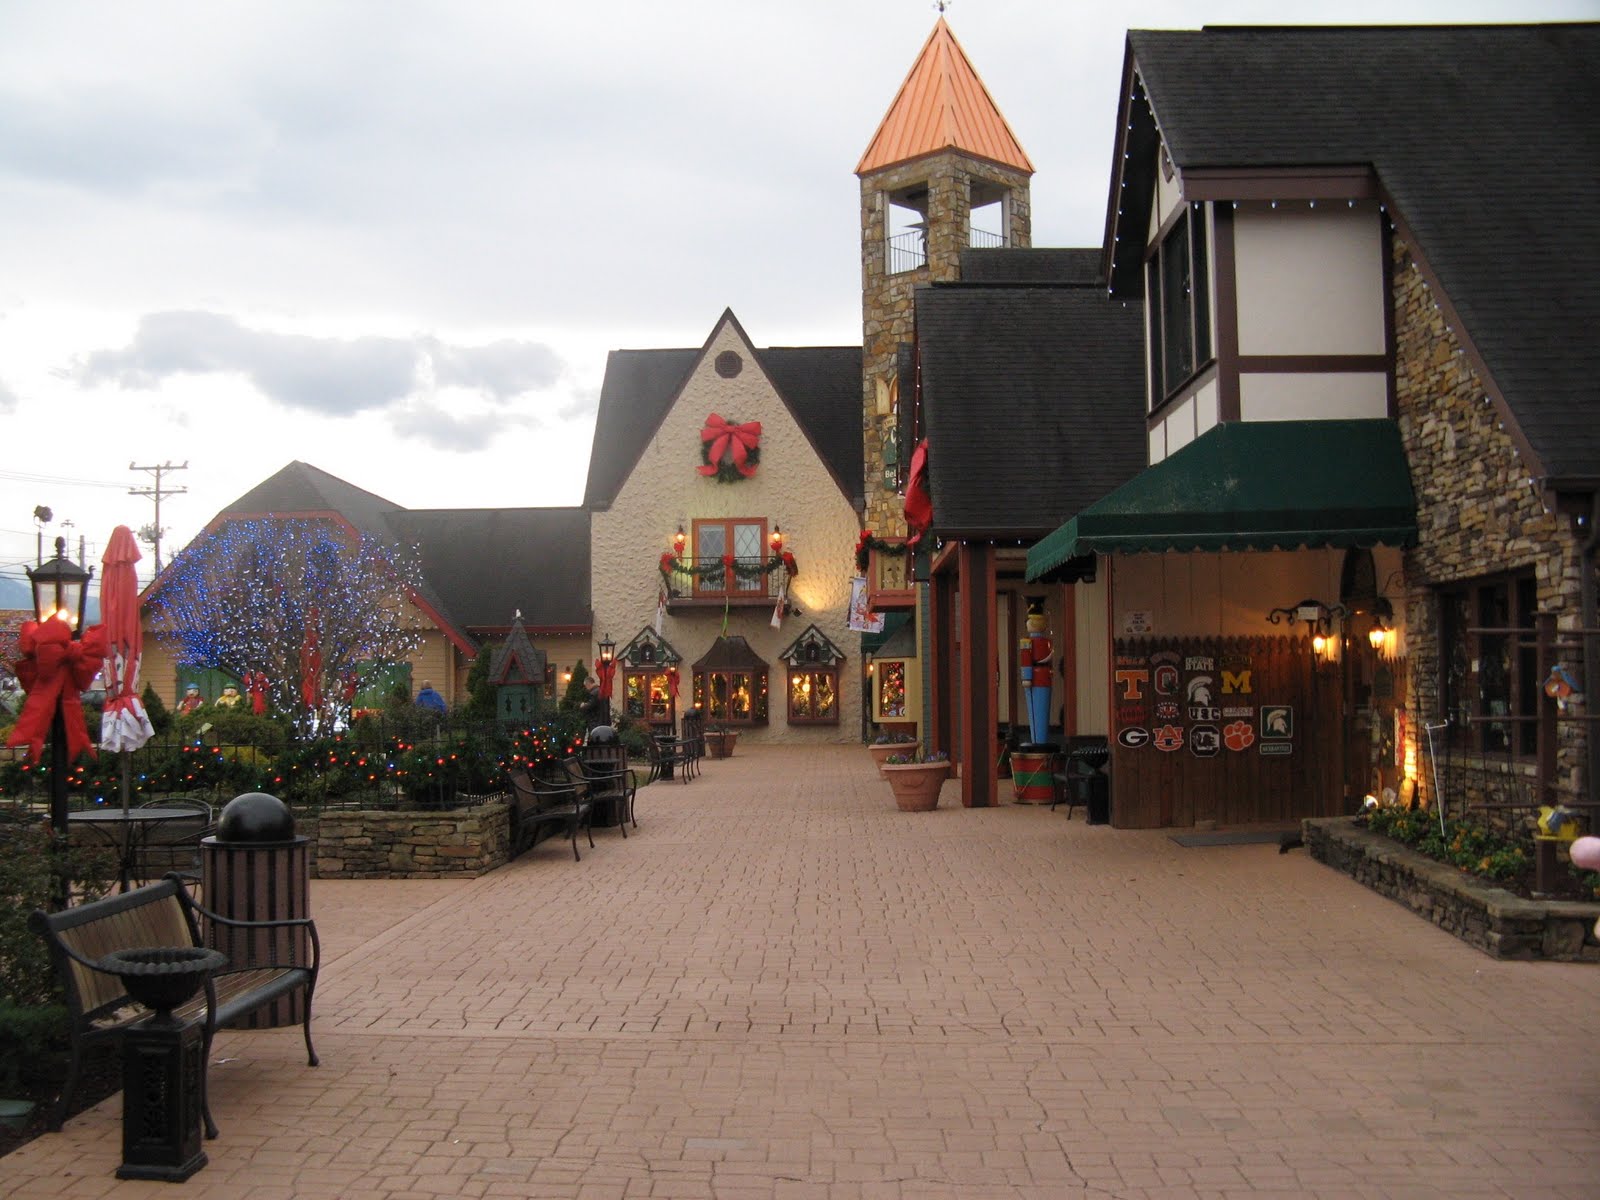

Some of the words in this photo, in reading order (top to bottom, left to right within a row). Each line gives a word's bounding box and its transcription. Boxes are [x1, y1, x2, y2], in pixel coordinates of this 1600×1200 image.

[1115, 669, 1149, 699] T
[1220, 670, 1253, 694] M
[1189, 707, 1221, 720] USC
